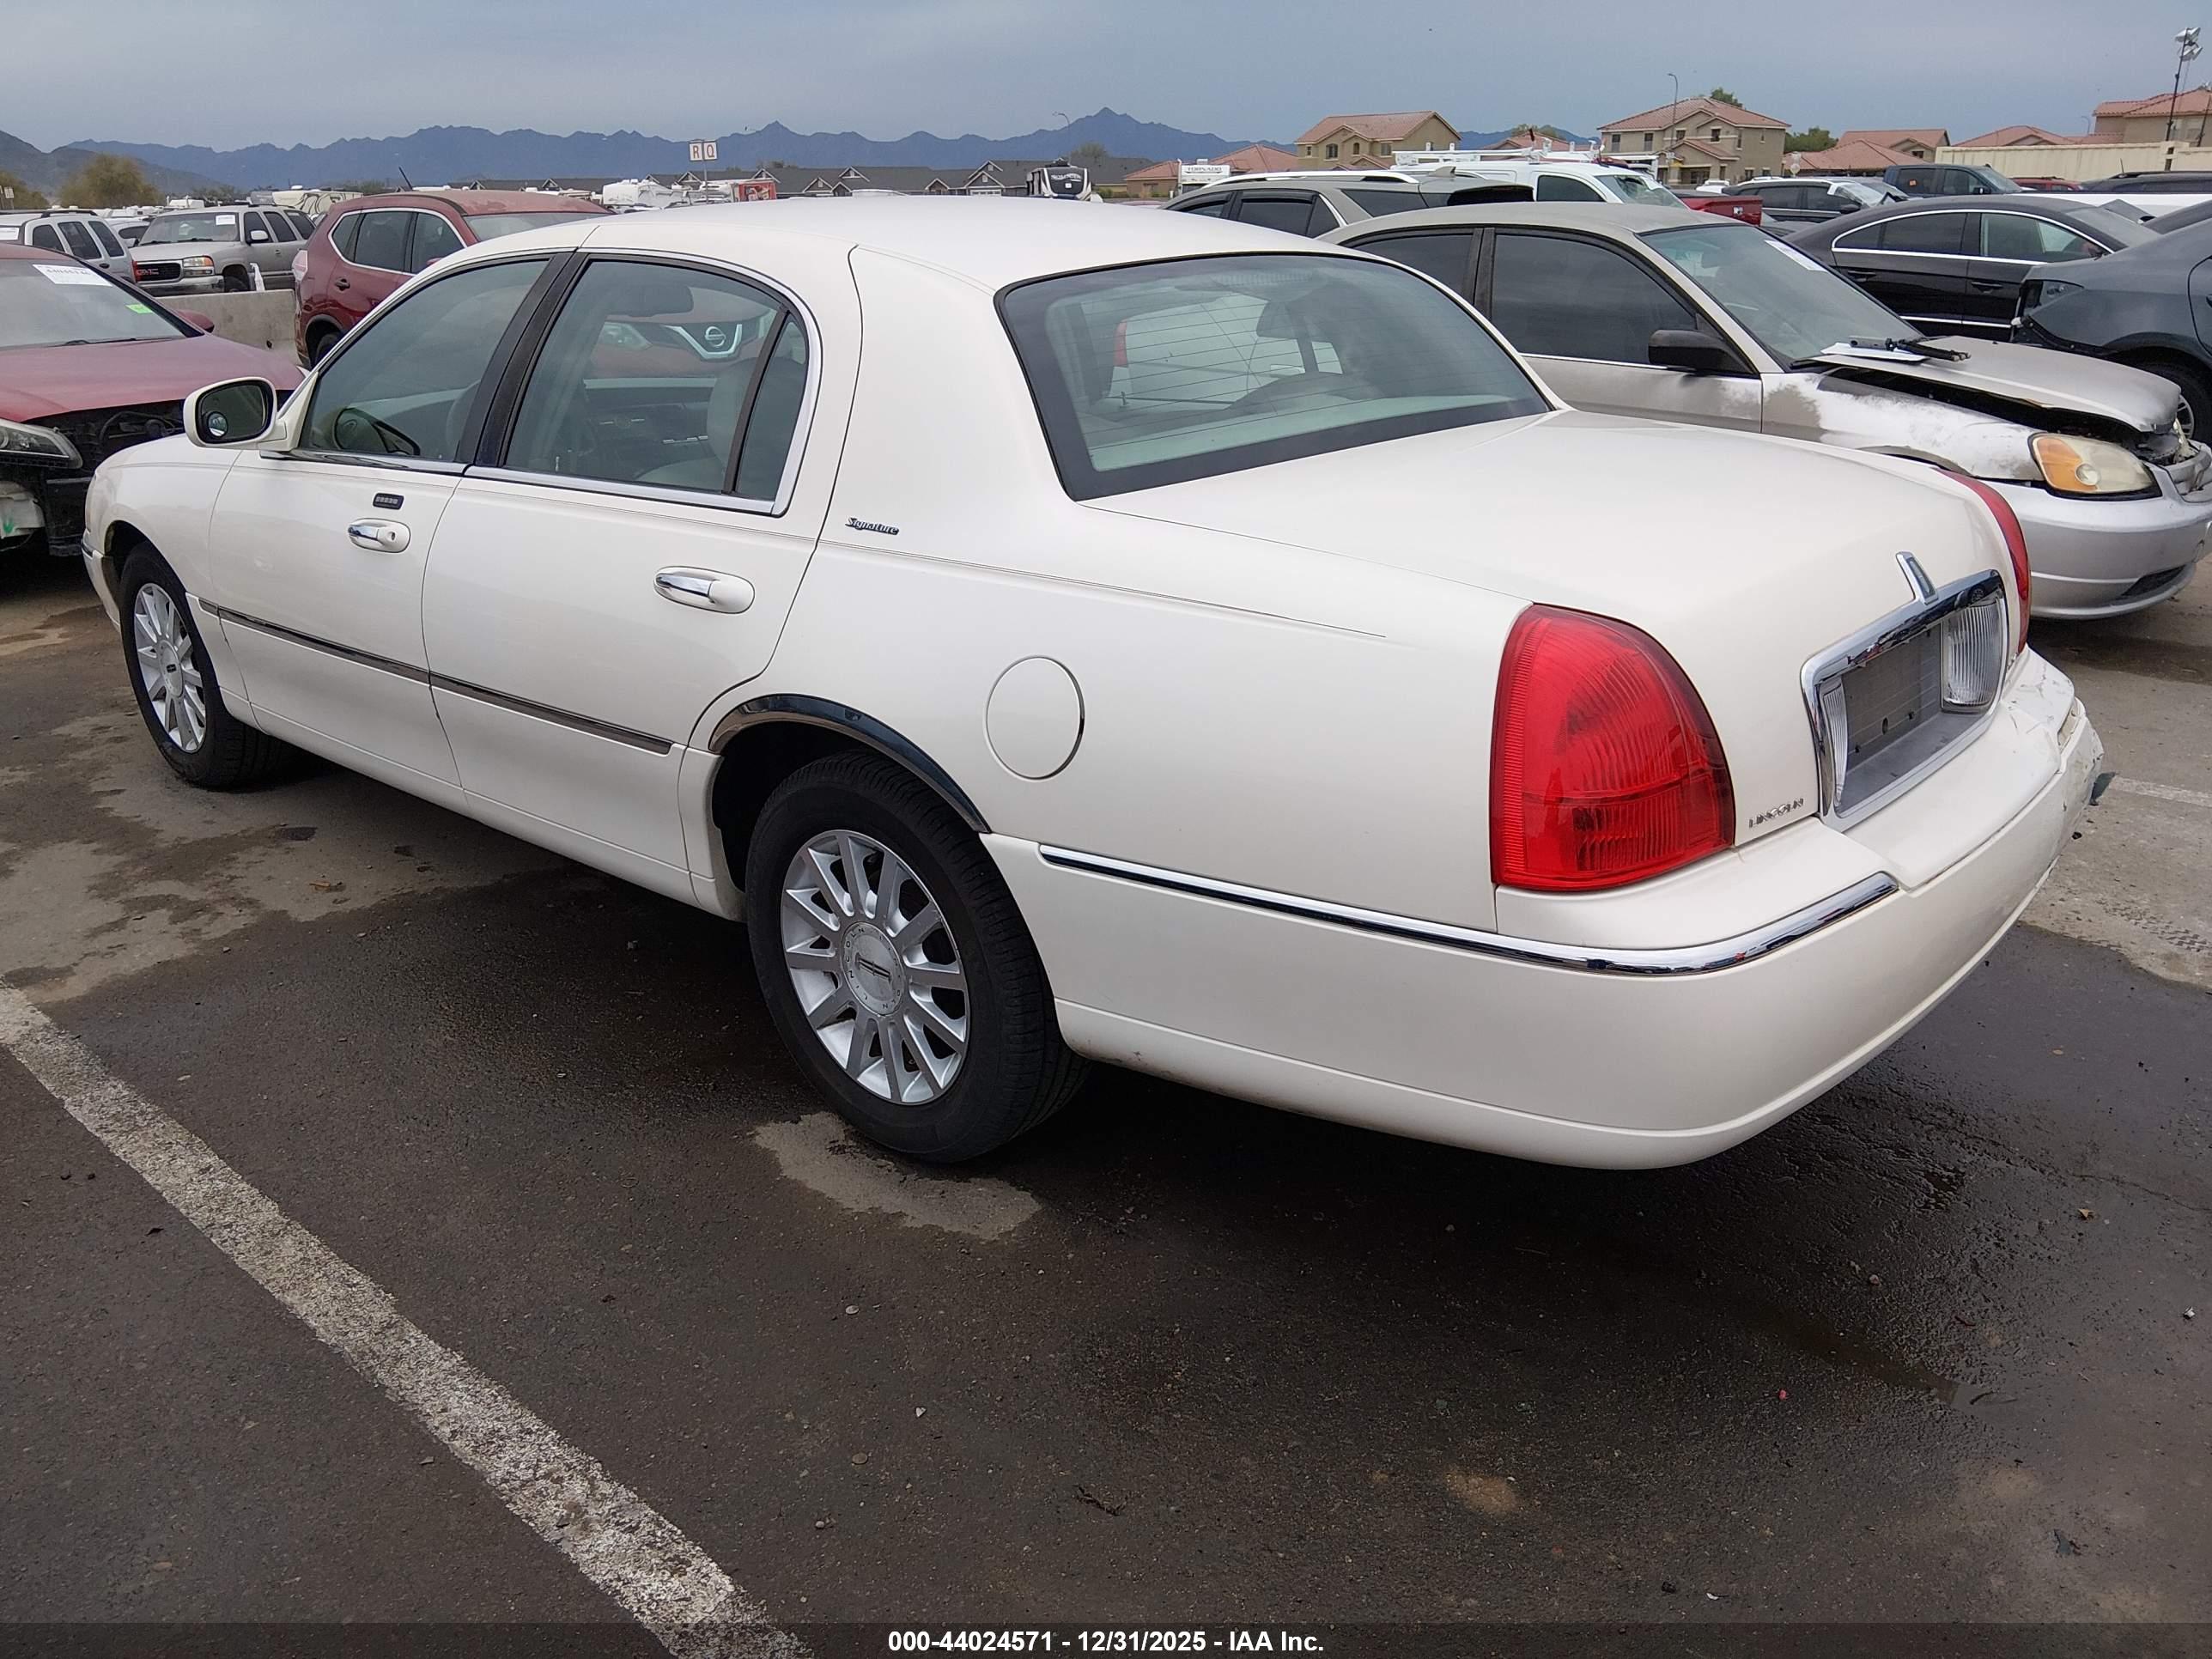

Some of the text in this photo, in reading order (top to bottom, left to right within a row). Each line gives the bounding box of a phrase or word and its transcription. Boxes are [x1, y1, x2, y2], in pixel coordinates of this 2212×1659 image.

[692, 144, 714, 159] R Q
[845, 517, 899, 535] Signature
[1749, 798, 1804, 829] LINCOLN
